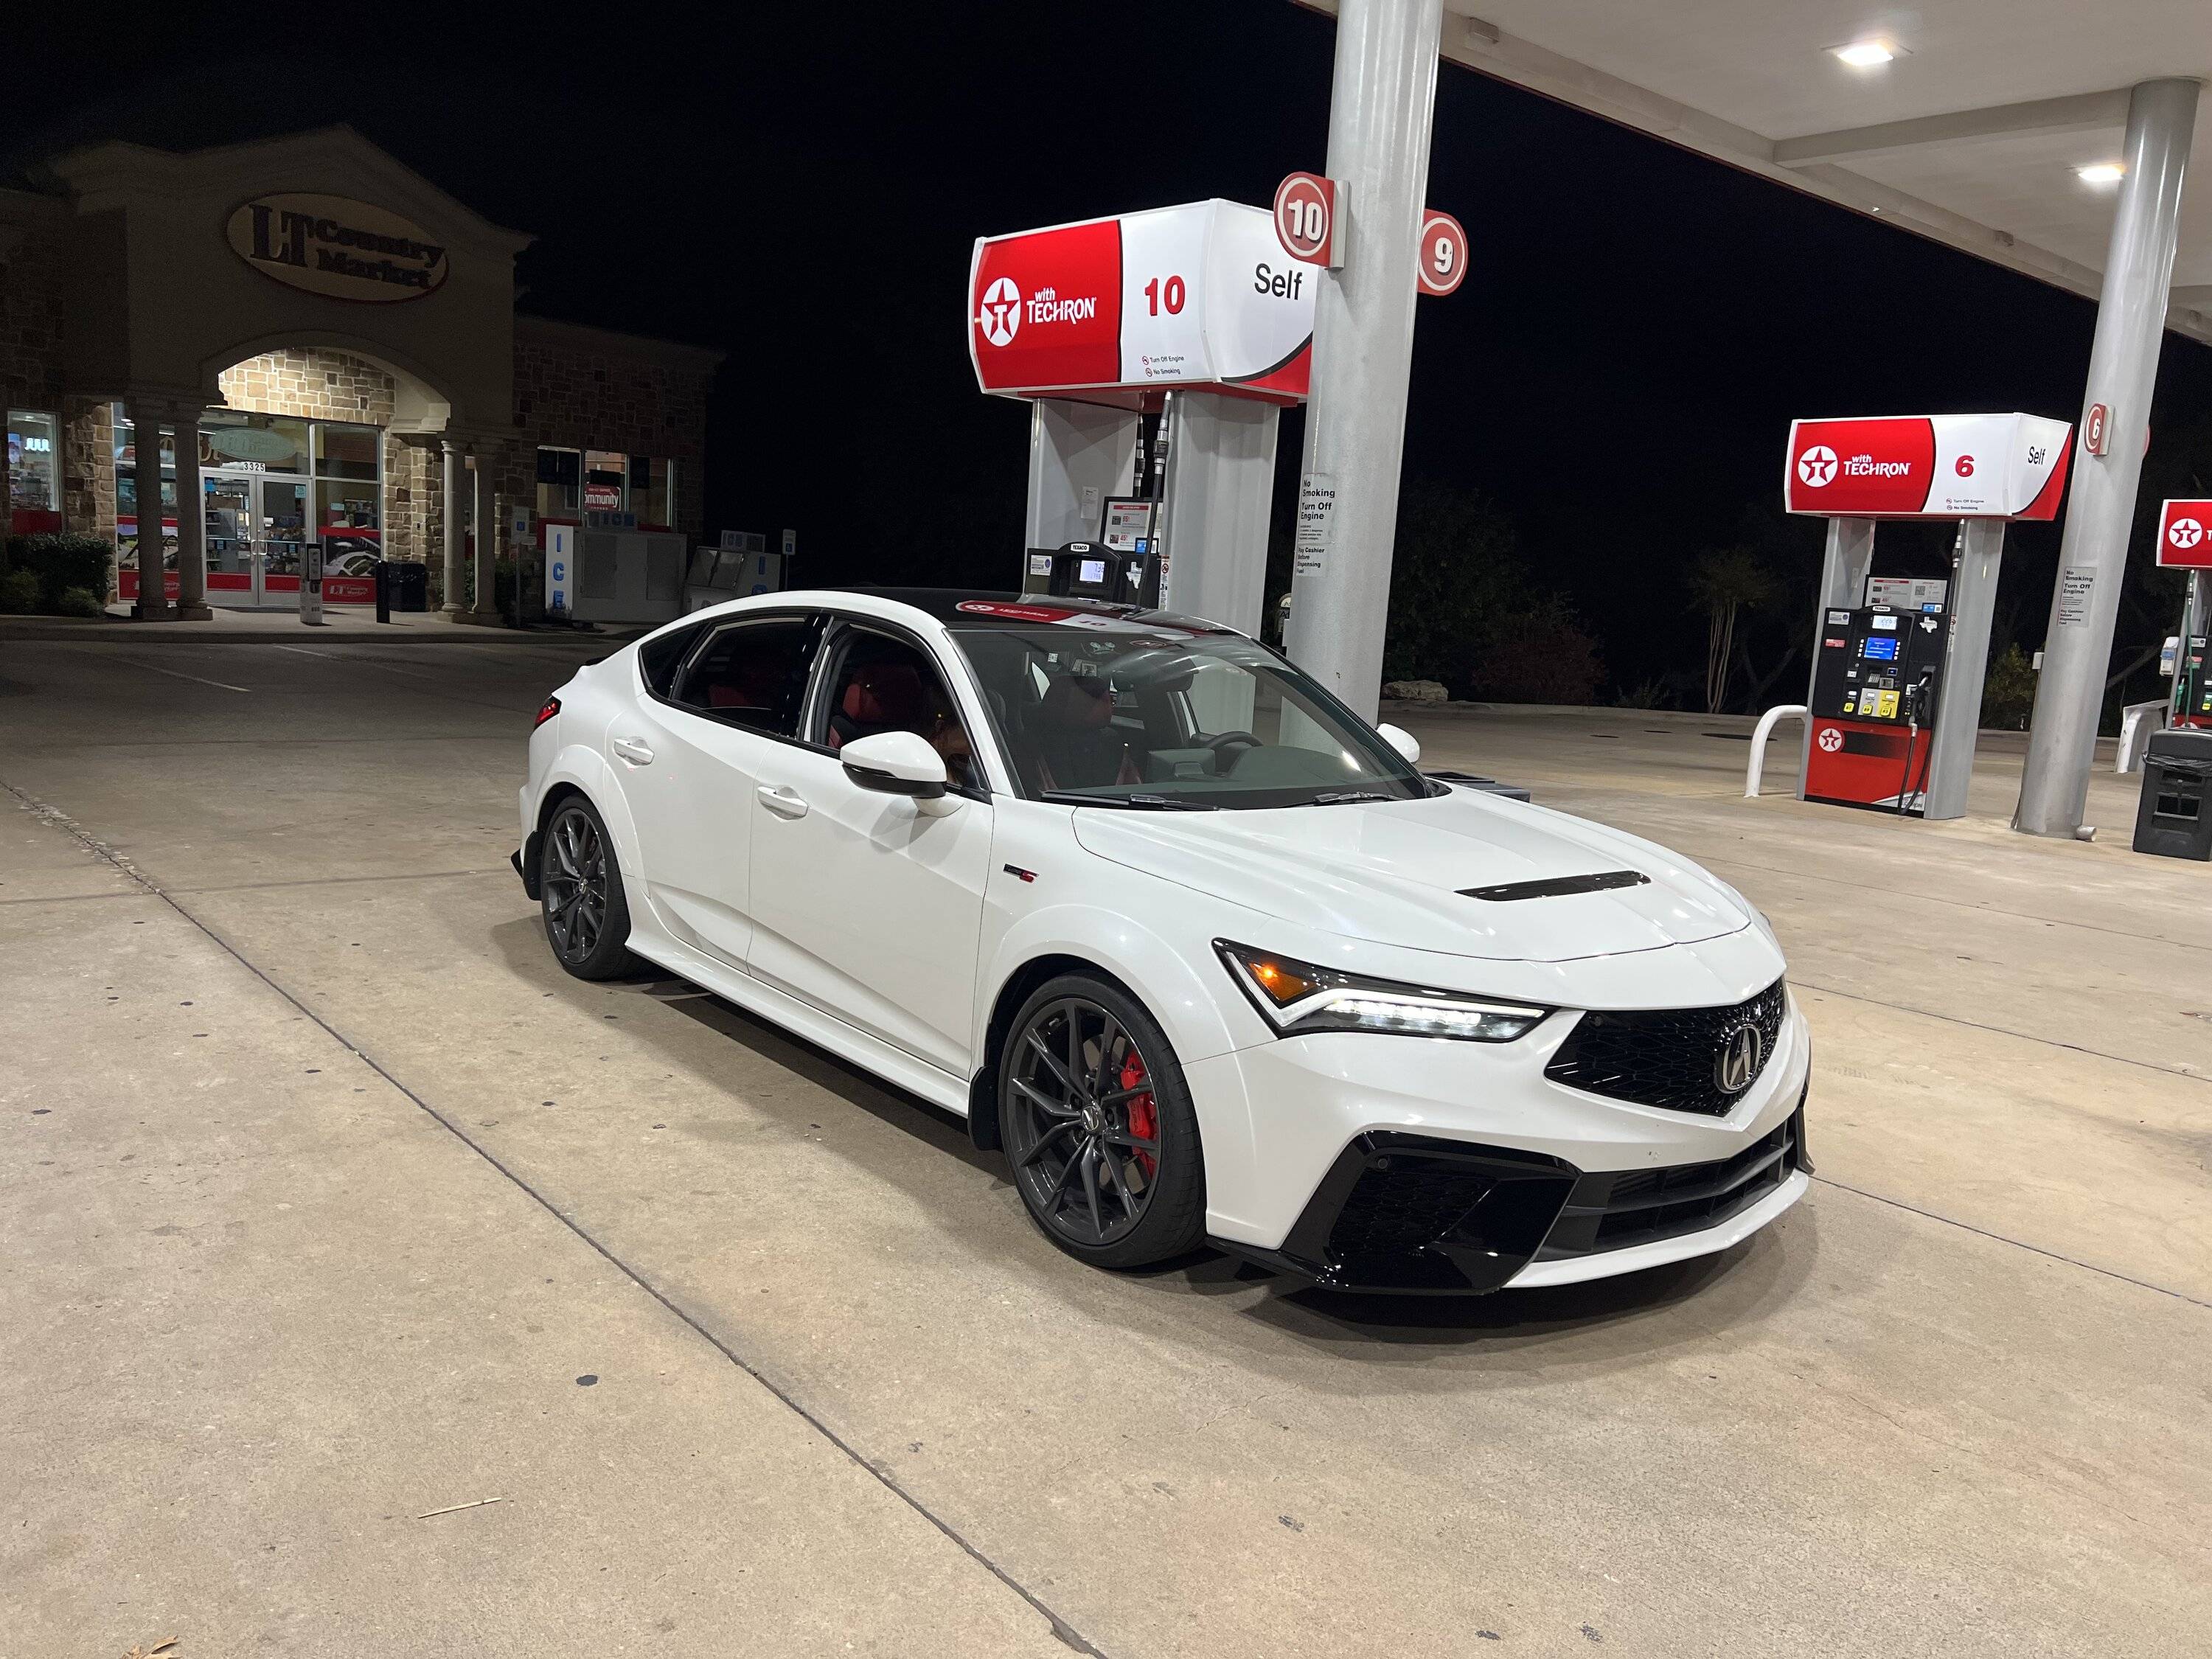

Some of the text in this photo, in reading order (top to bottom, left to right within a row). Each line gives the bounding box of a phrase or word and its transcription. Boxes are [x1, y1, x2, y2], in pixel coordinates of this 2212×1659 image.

[1288, 199, 1323, 241] 10
[248, 204, 318, 268] LT
[316, 219, 446, 268] Country
[1434, 237, 1453, 273] 9
[316, 248, 431, 289] Market
[1254, 263, 1302, 300] Self
[1035, 287, 1056, 302] with
[1145, 275, 1185, 316] 10
[1026, 297, 1096, 324] TECHRON
[2093, 418, 2100, 439] 6
[244, 462, 265, 471] 3325
[1851, 454, 1872, 463] with
[1955, 455, 1975, 478] 6
[2028, 446, 2046, 465] Self
[1843, 461, 1910, 478] TECHRON
[1303, 488, 1335, 498] Smoking
[1301, 502, 1332, 510] Turn Off
[1301, 512, 1324, 521] Engine
